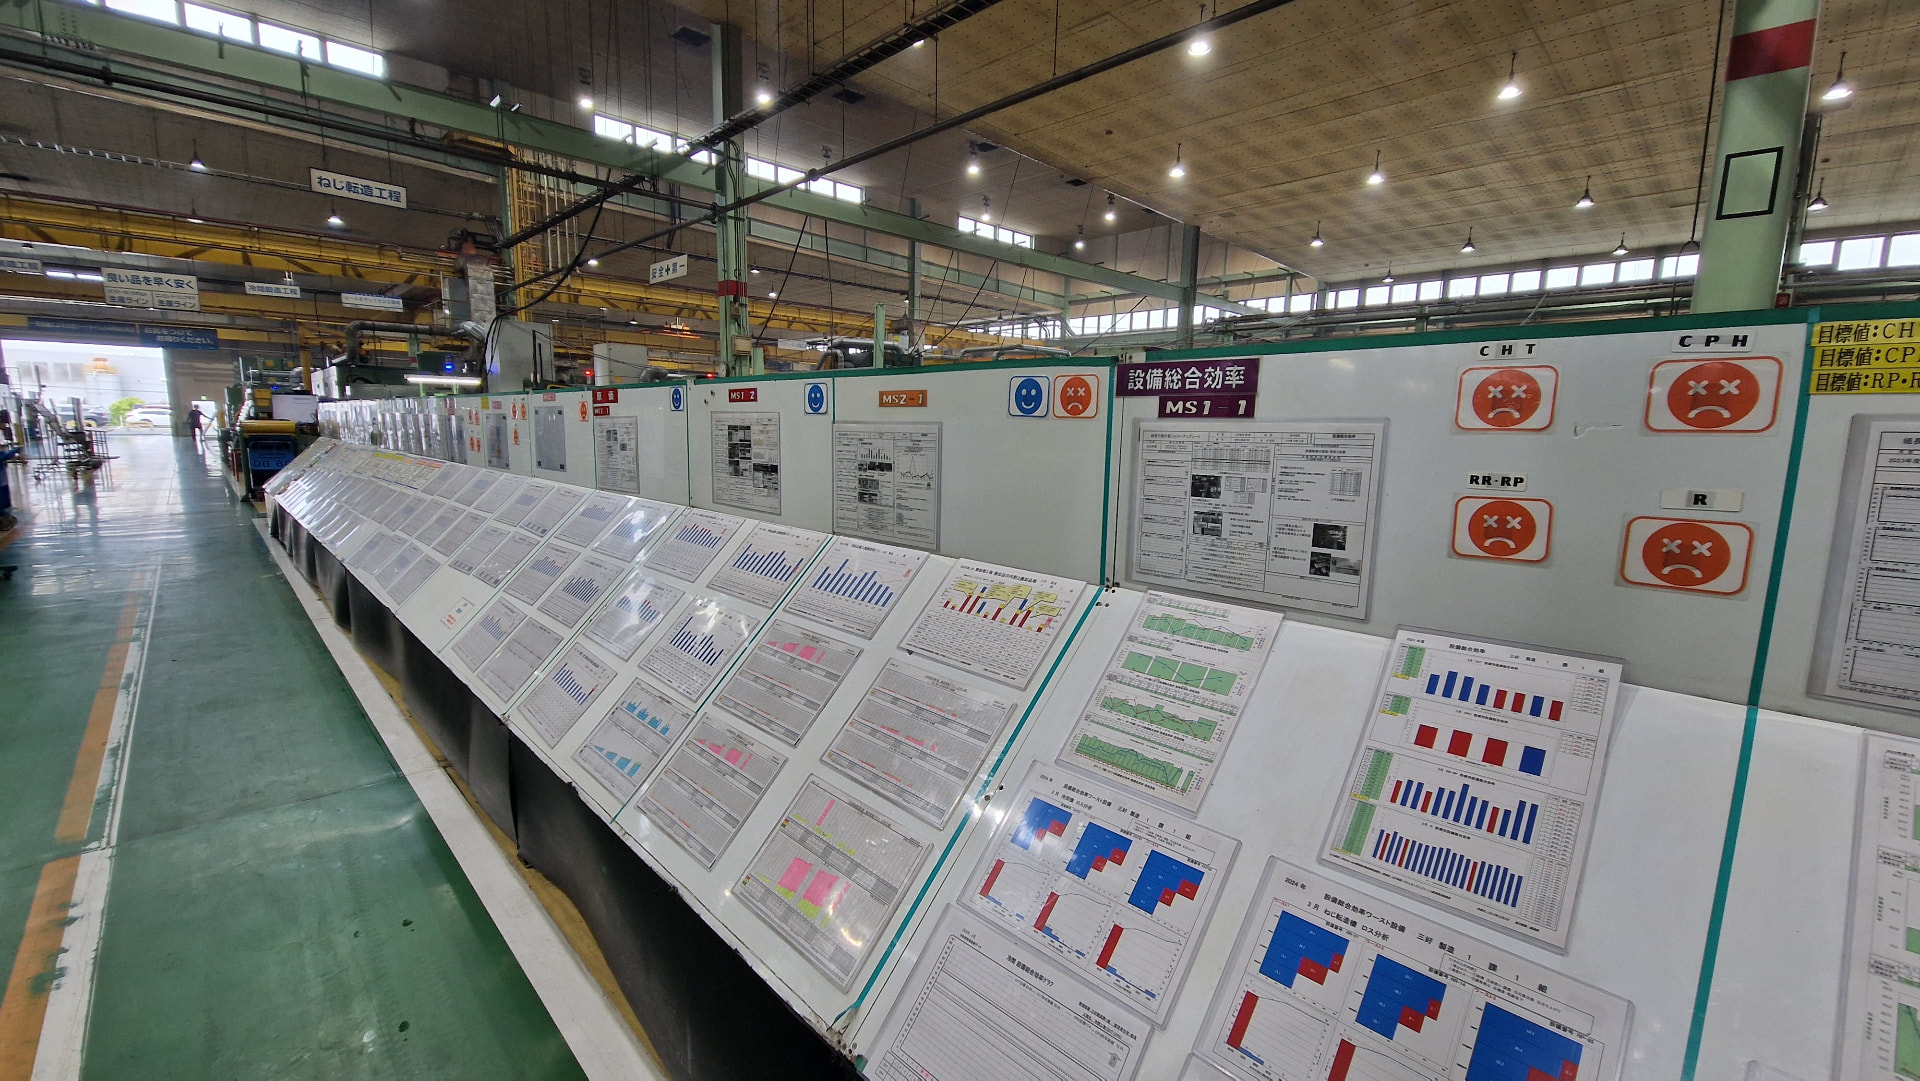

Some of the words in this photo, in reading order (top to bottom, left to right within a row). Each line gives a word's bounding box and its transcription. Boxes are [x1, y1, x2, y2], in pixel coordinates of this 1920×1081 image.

[317, 175, 402, 203] ねじ転造工程
[651, 266, 664, 280] 安全
[672, 261, 685, 274] 第一
[107, 272, 195, 290] 良い品を早く安く
[158, 299, 196, 309] 生産ライン
[1678, 334, 1748, 348] CPH
[1818, 321, 1920, 344] 目標値：CH
[1479, 343, 1536, 357] CHT
[1819, 346, 1920, 368] 目標値：CP
[1128, 365, 1246, 390] 設備総合効率
[1692, 493, 1708, 506] R
[1284, 877, 1299, 887] 2024
[1312, 903, 1320, 911] 月
[1323, 908, 1358, 928] ねじ転造機
[1361, 924, 1390, 942] ロス分析
[1323, 893, 1406, 934] 設備総合効率ワースト設備
[1417, 932, 1434, 945] 三好
[1438, 941, 1456, 955] 製造
[1488, 962, 1498, 972] 課
[1537, 983, 1548, 993] 組
